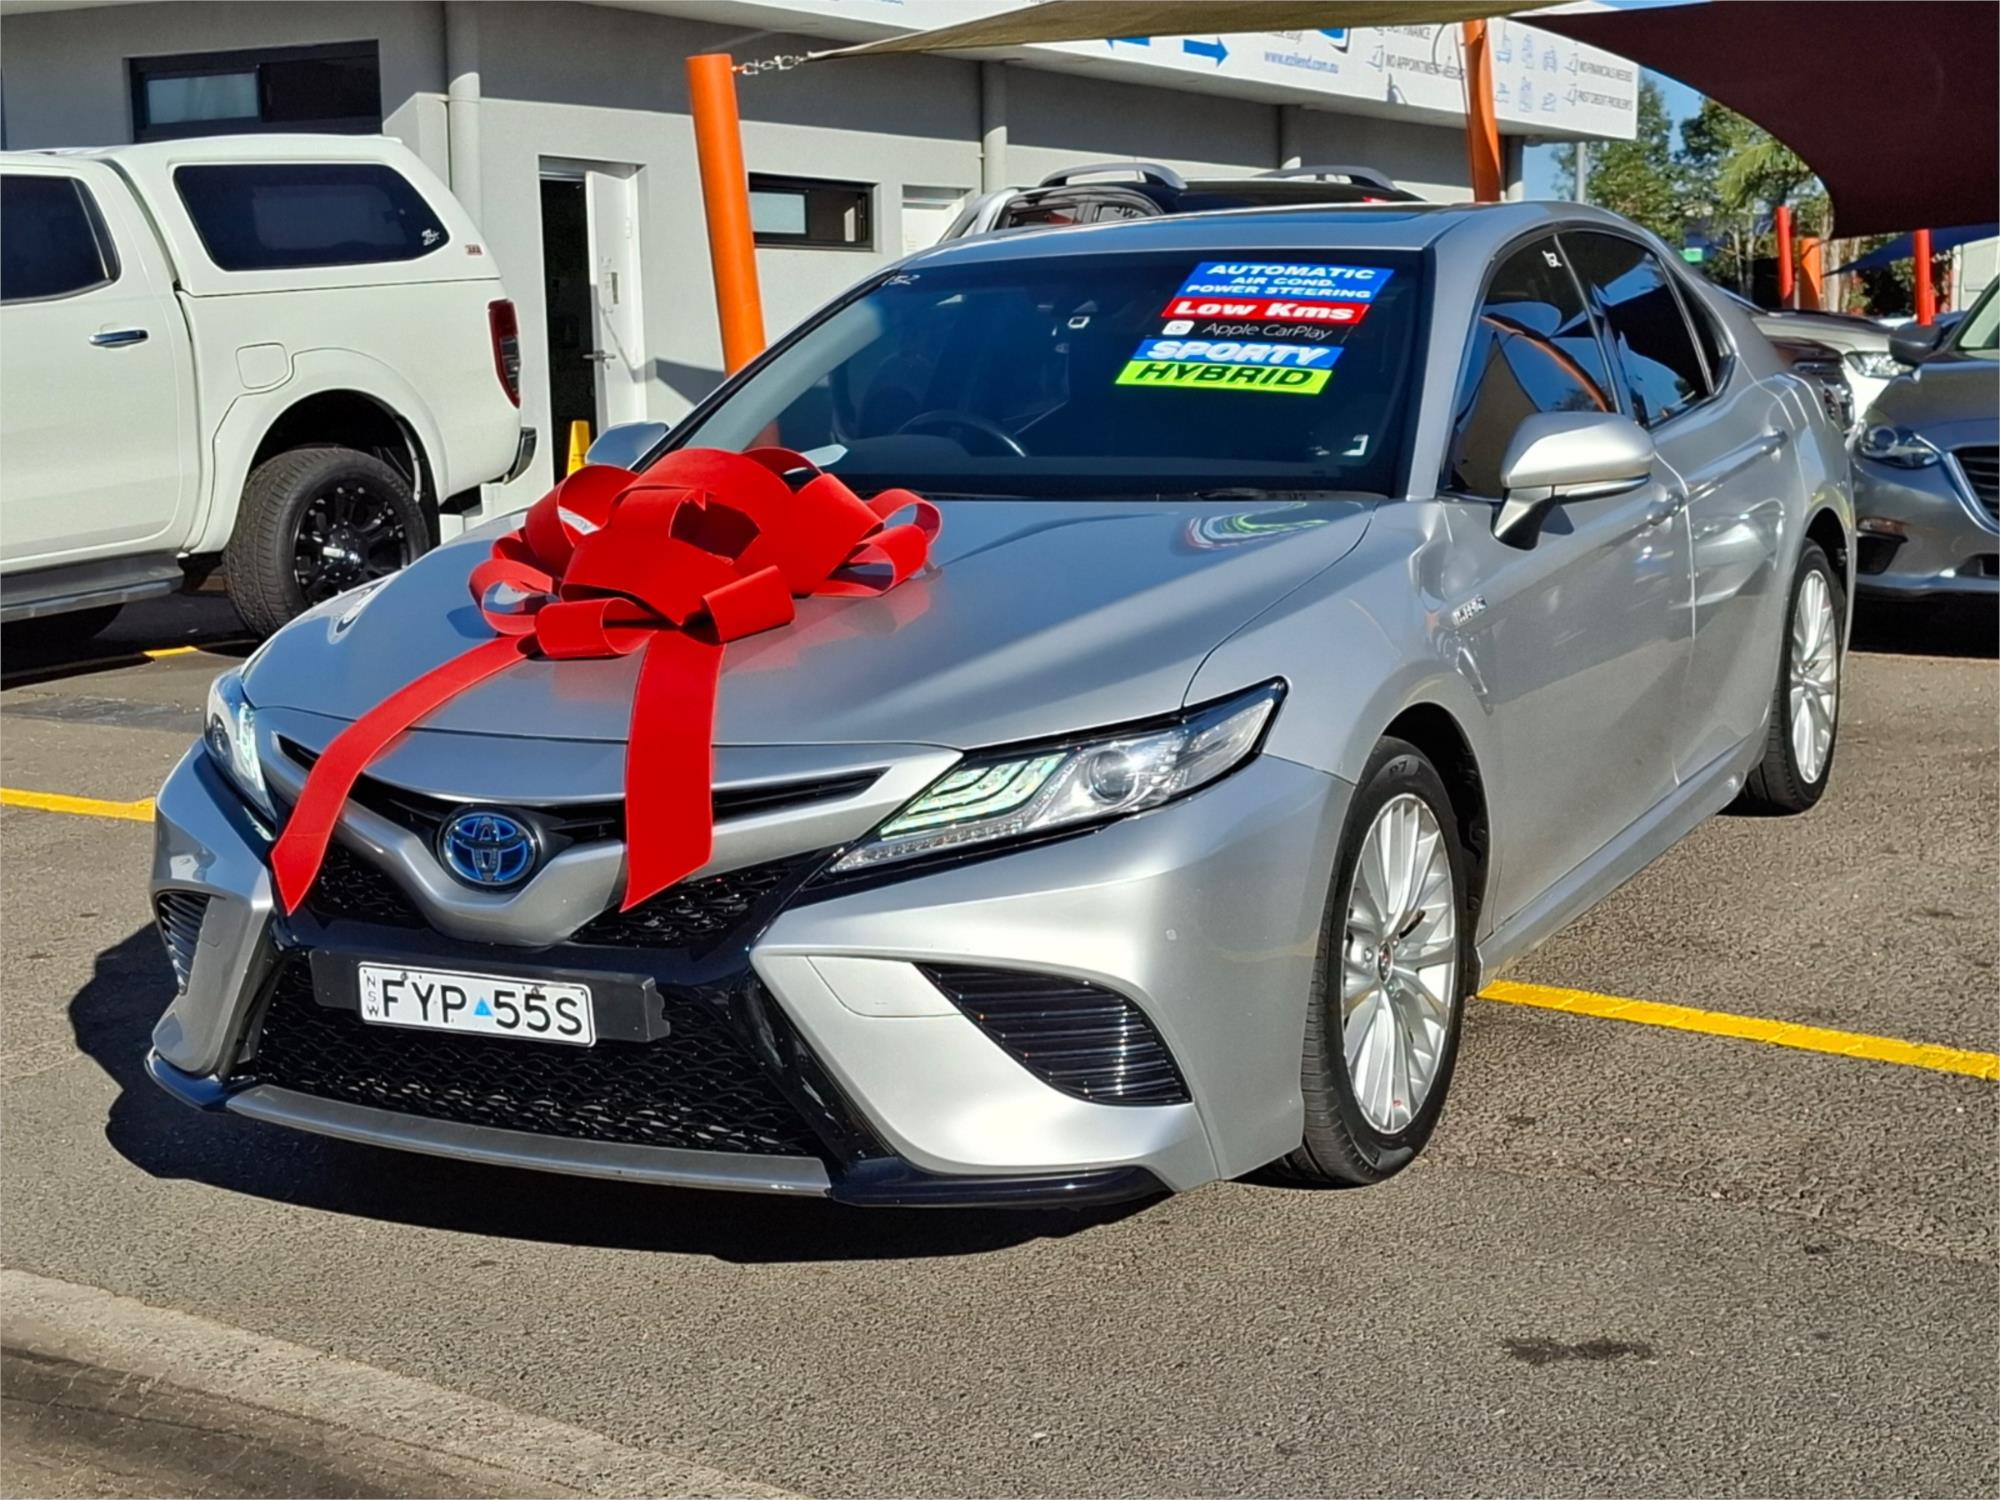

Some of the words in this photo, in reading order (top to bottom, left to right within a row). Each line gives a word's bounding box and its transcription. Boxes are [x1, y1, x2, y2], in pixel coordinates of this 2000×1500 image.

[1206, 264, 1376, 280] AUTOMATIC
[1186, 284, 1260, 295] POWER
[1265, 286, 1371, 299] STEERING
[1231, 276, 1267, 285] AIR
[1276, 277, 1336, 288] COND.
[1173, 301, 1258, 316] Low
[1264, 302, 1355, 321] Kms
[1201, 322, 1260, 338] Apple
[1261, 323, 1333, 341] CarPlay
[1146, 340, 1330, 366] SPORTY
[1134, 363, 1314, 387] HYBRID
